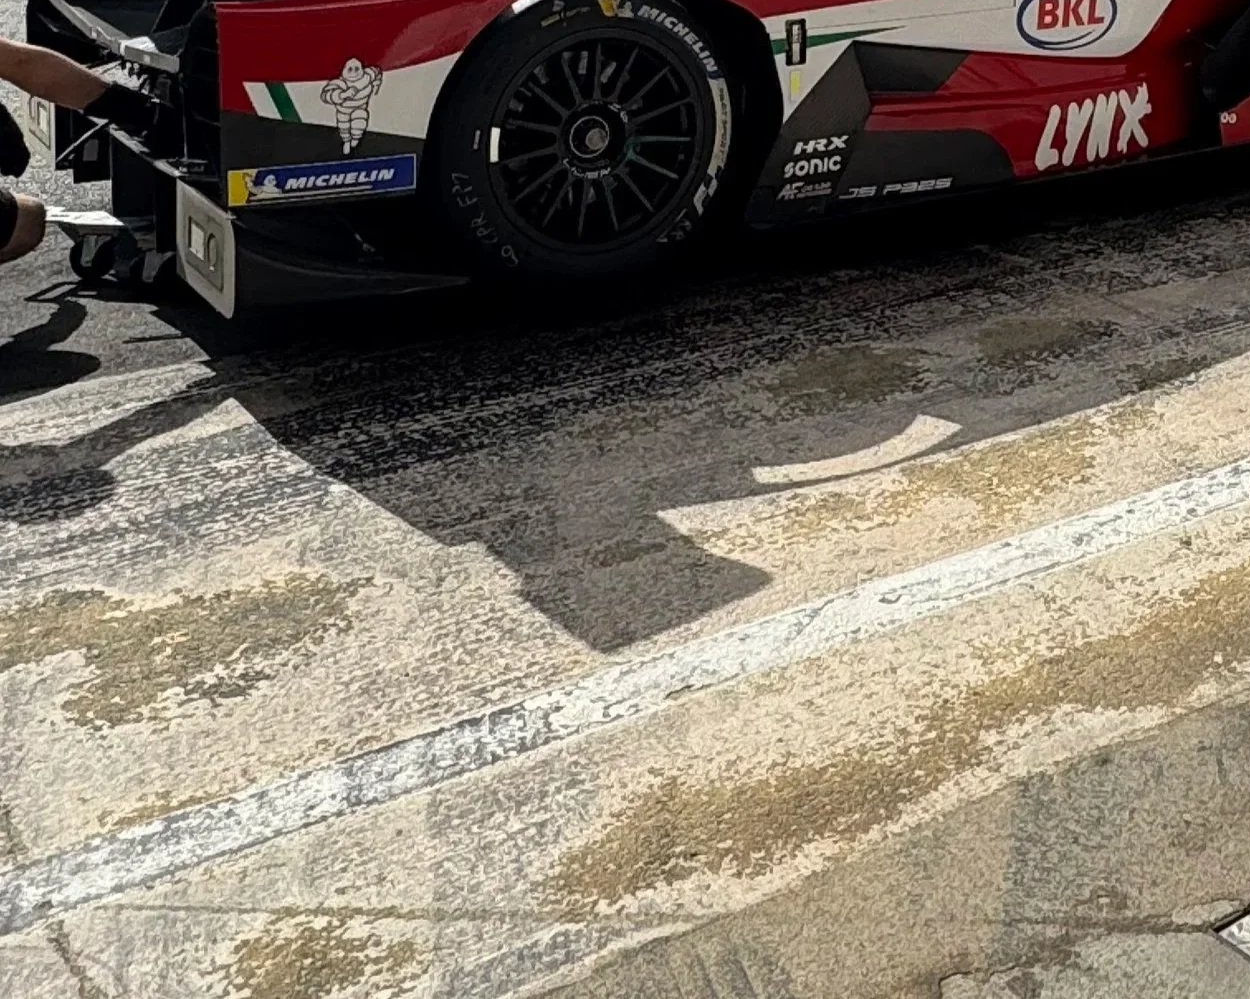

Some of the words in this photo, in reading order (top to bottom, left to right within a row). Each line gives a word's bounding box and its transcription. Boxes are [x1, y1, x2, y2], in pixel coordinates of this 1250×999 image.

[637, 5, 719, 72] MICHELIN
[794, 135, 849, 155] HRX
[1035, 81, 1152, 171] LYNX
[285, 169, 395, 190] MICHELIN
